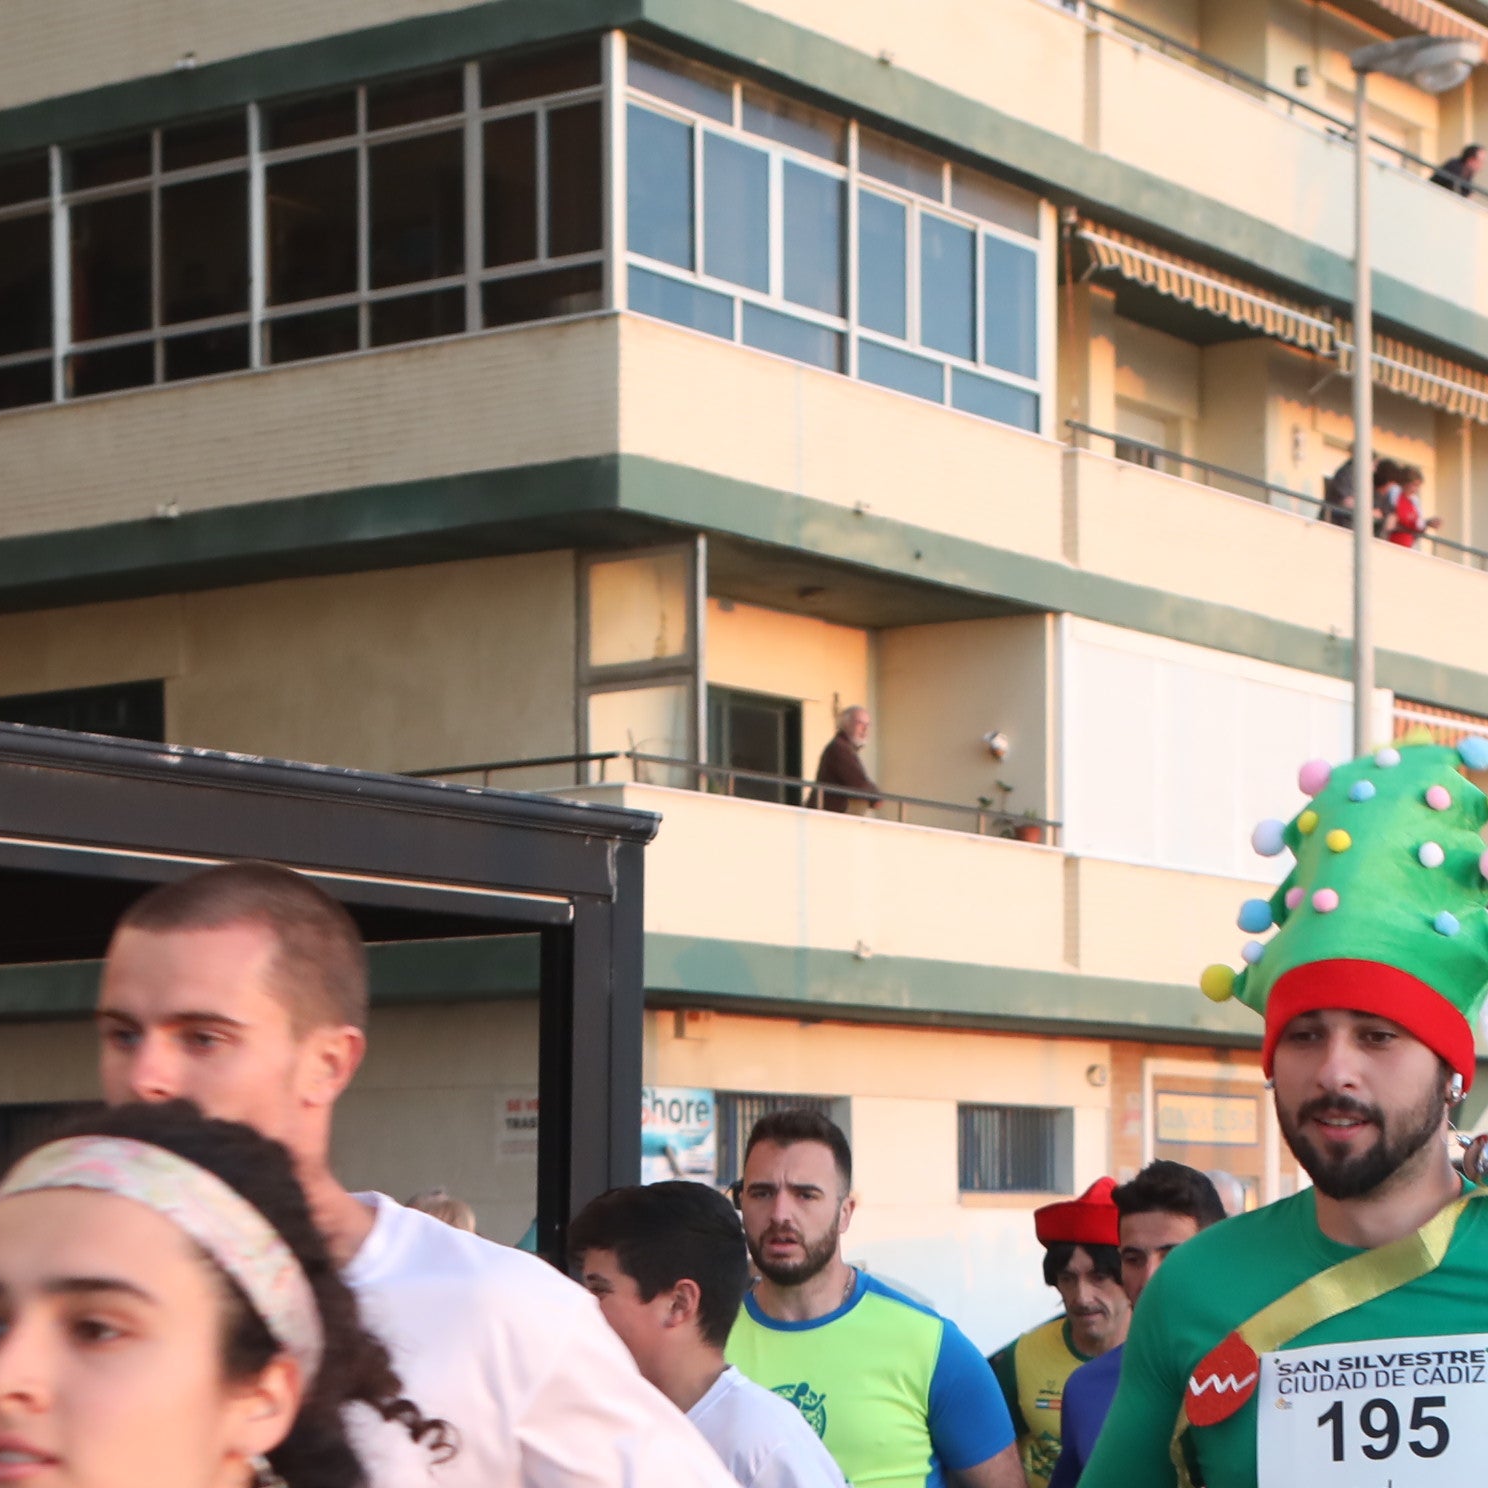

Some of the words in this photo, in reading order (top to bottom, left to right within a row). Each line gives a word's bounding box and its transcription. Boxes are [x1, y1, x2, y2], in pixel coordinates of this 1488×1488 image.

[642, 1088, 710, 1123] hore
[1277, 1358, 1330, 1377] SAN
[1338, 1349, 1485, 1371] SILVESTRE
[1278, 1371, 1367, 1395] CIUDAD
[1375, 1369, 1405, 1387] DE
[1318, 1396, 1450, 1462] 195
